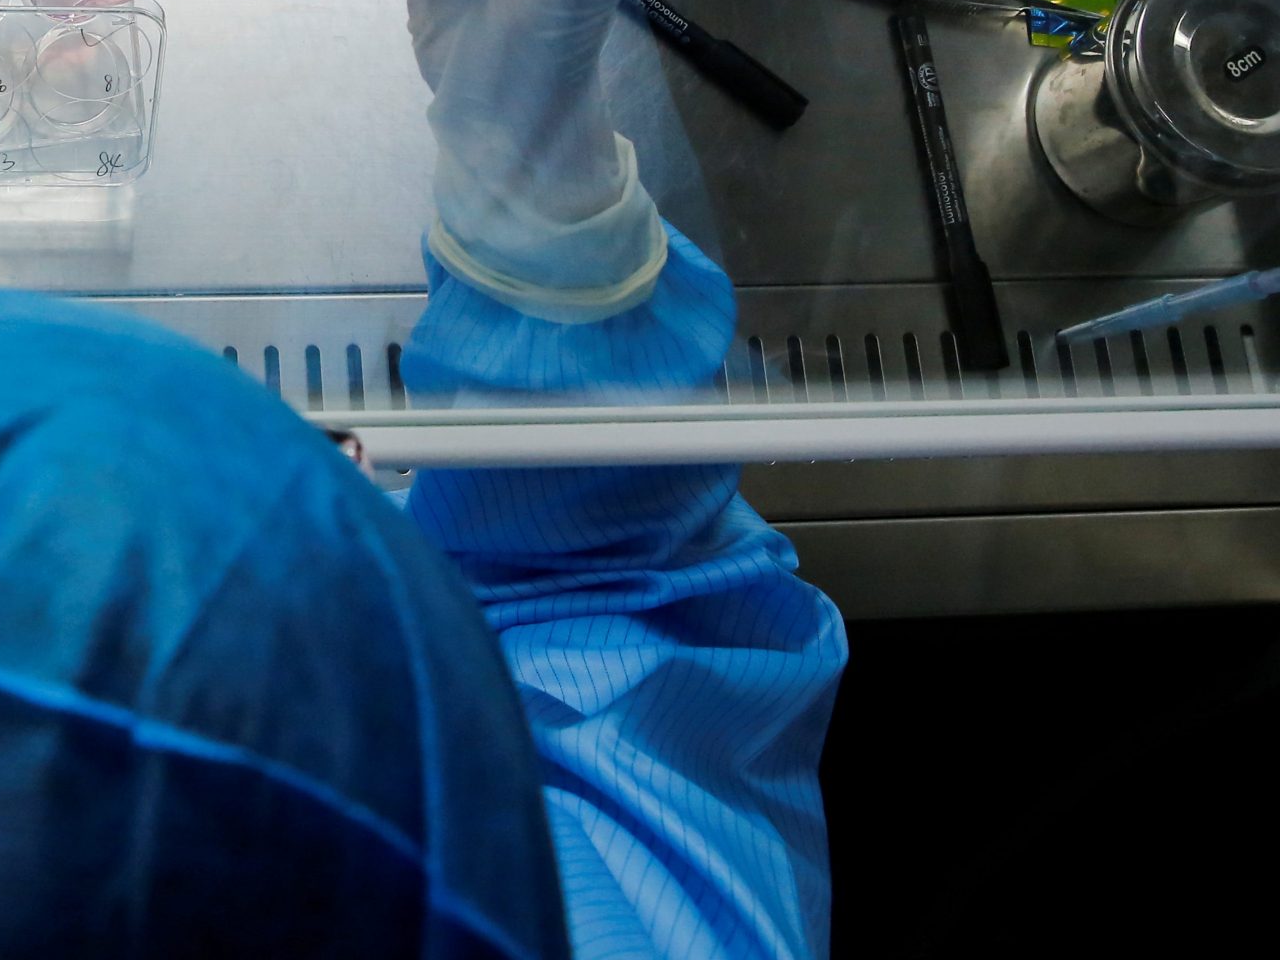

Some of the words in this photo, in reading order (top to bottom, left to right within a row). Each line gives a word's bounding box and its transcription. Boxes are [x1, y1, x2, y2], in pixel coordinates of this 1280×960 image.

[1226, 50, 1261, 77] 8cm
[96, 151, 124, 177] 84
[938, 171, 955, 224] Lumocolor
